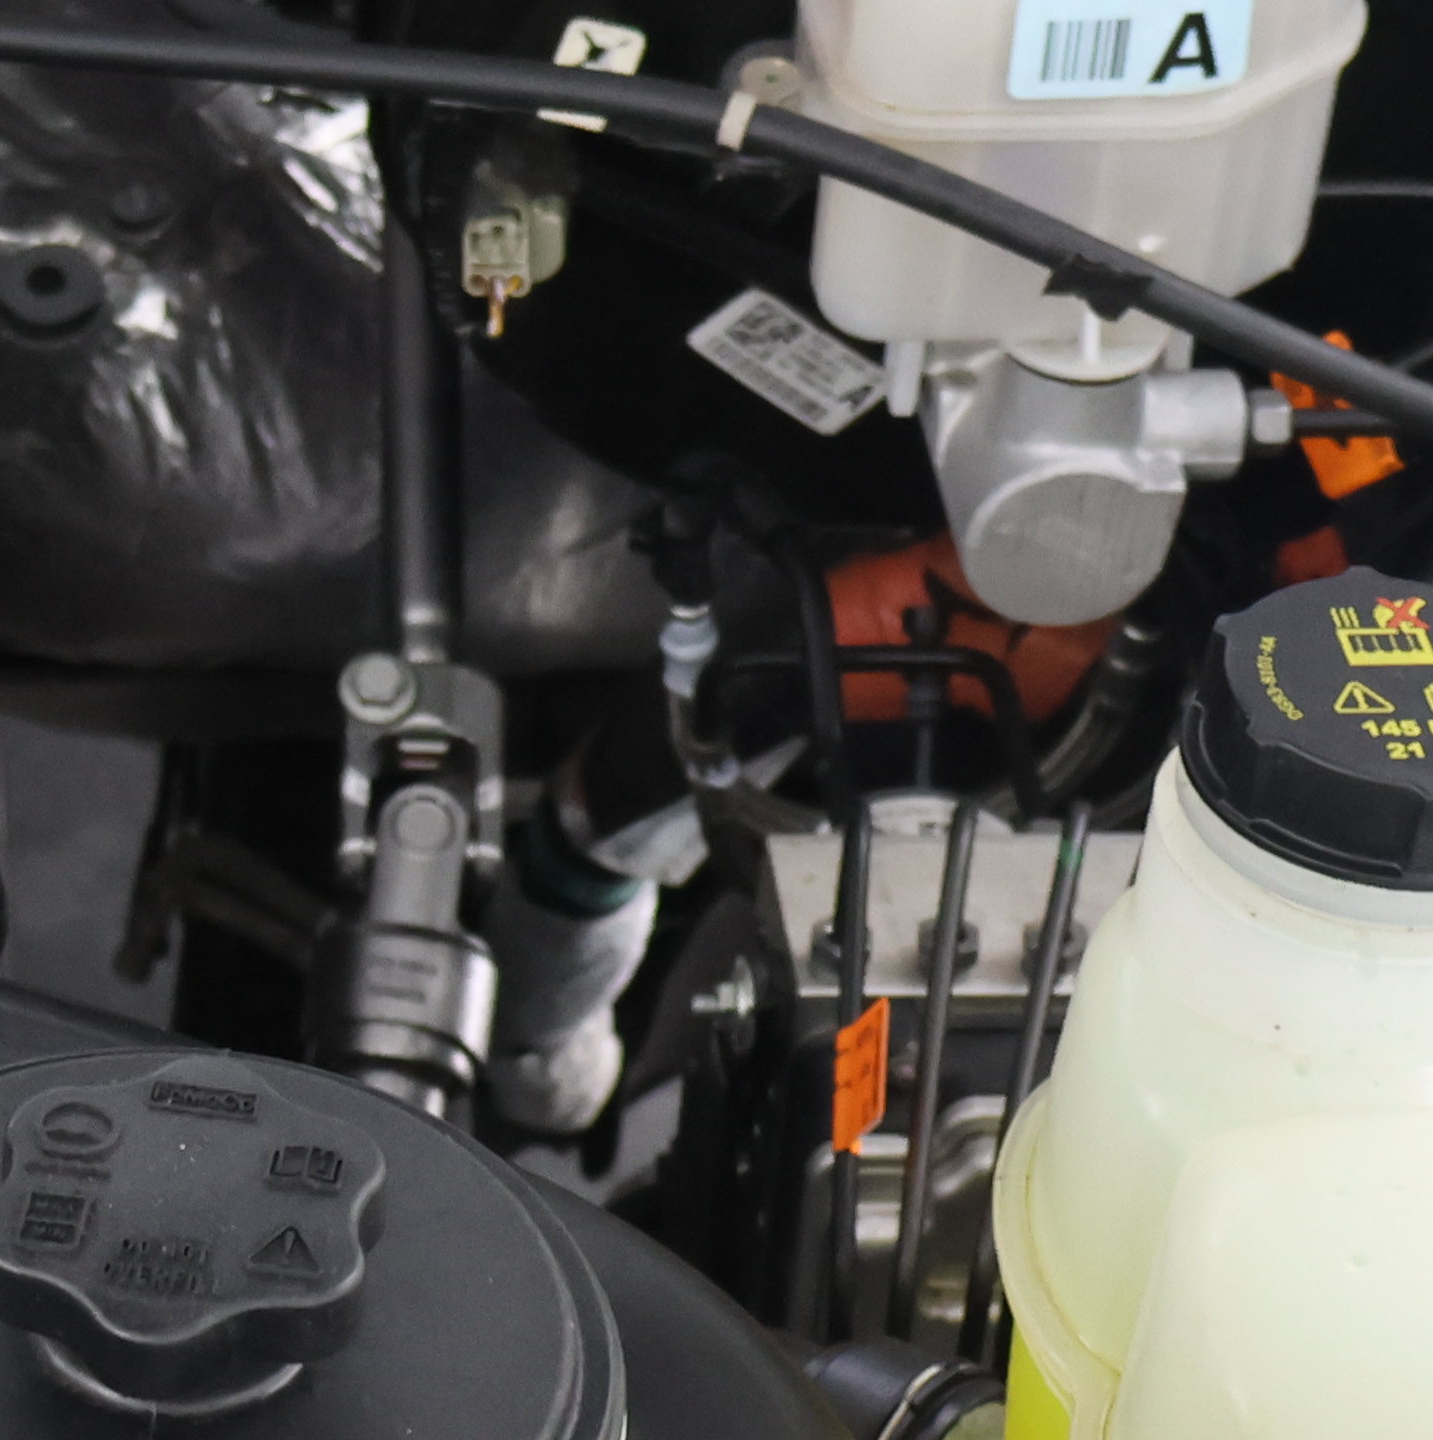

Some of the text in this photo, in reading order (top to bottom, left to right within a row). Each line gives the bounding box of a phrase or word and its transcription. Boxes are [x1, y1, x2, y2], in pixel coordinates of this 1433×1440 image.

[1148, 11, 1220, 86] A
[1360, 718, 1422, 737] 145
[1385, 740, 1426, 760] 21
